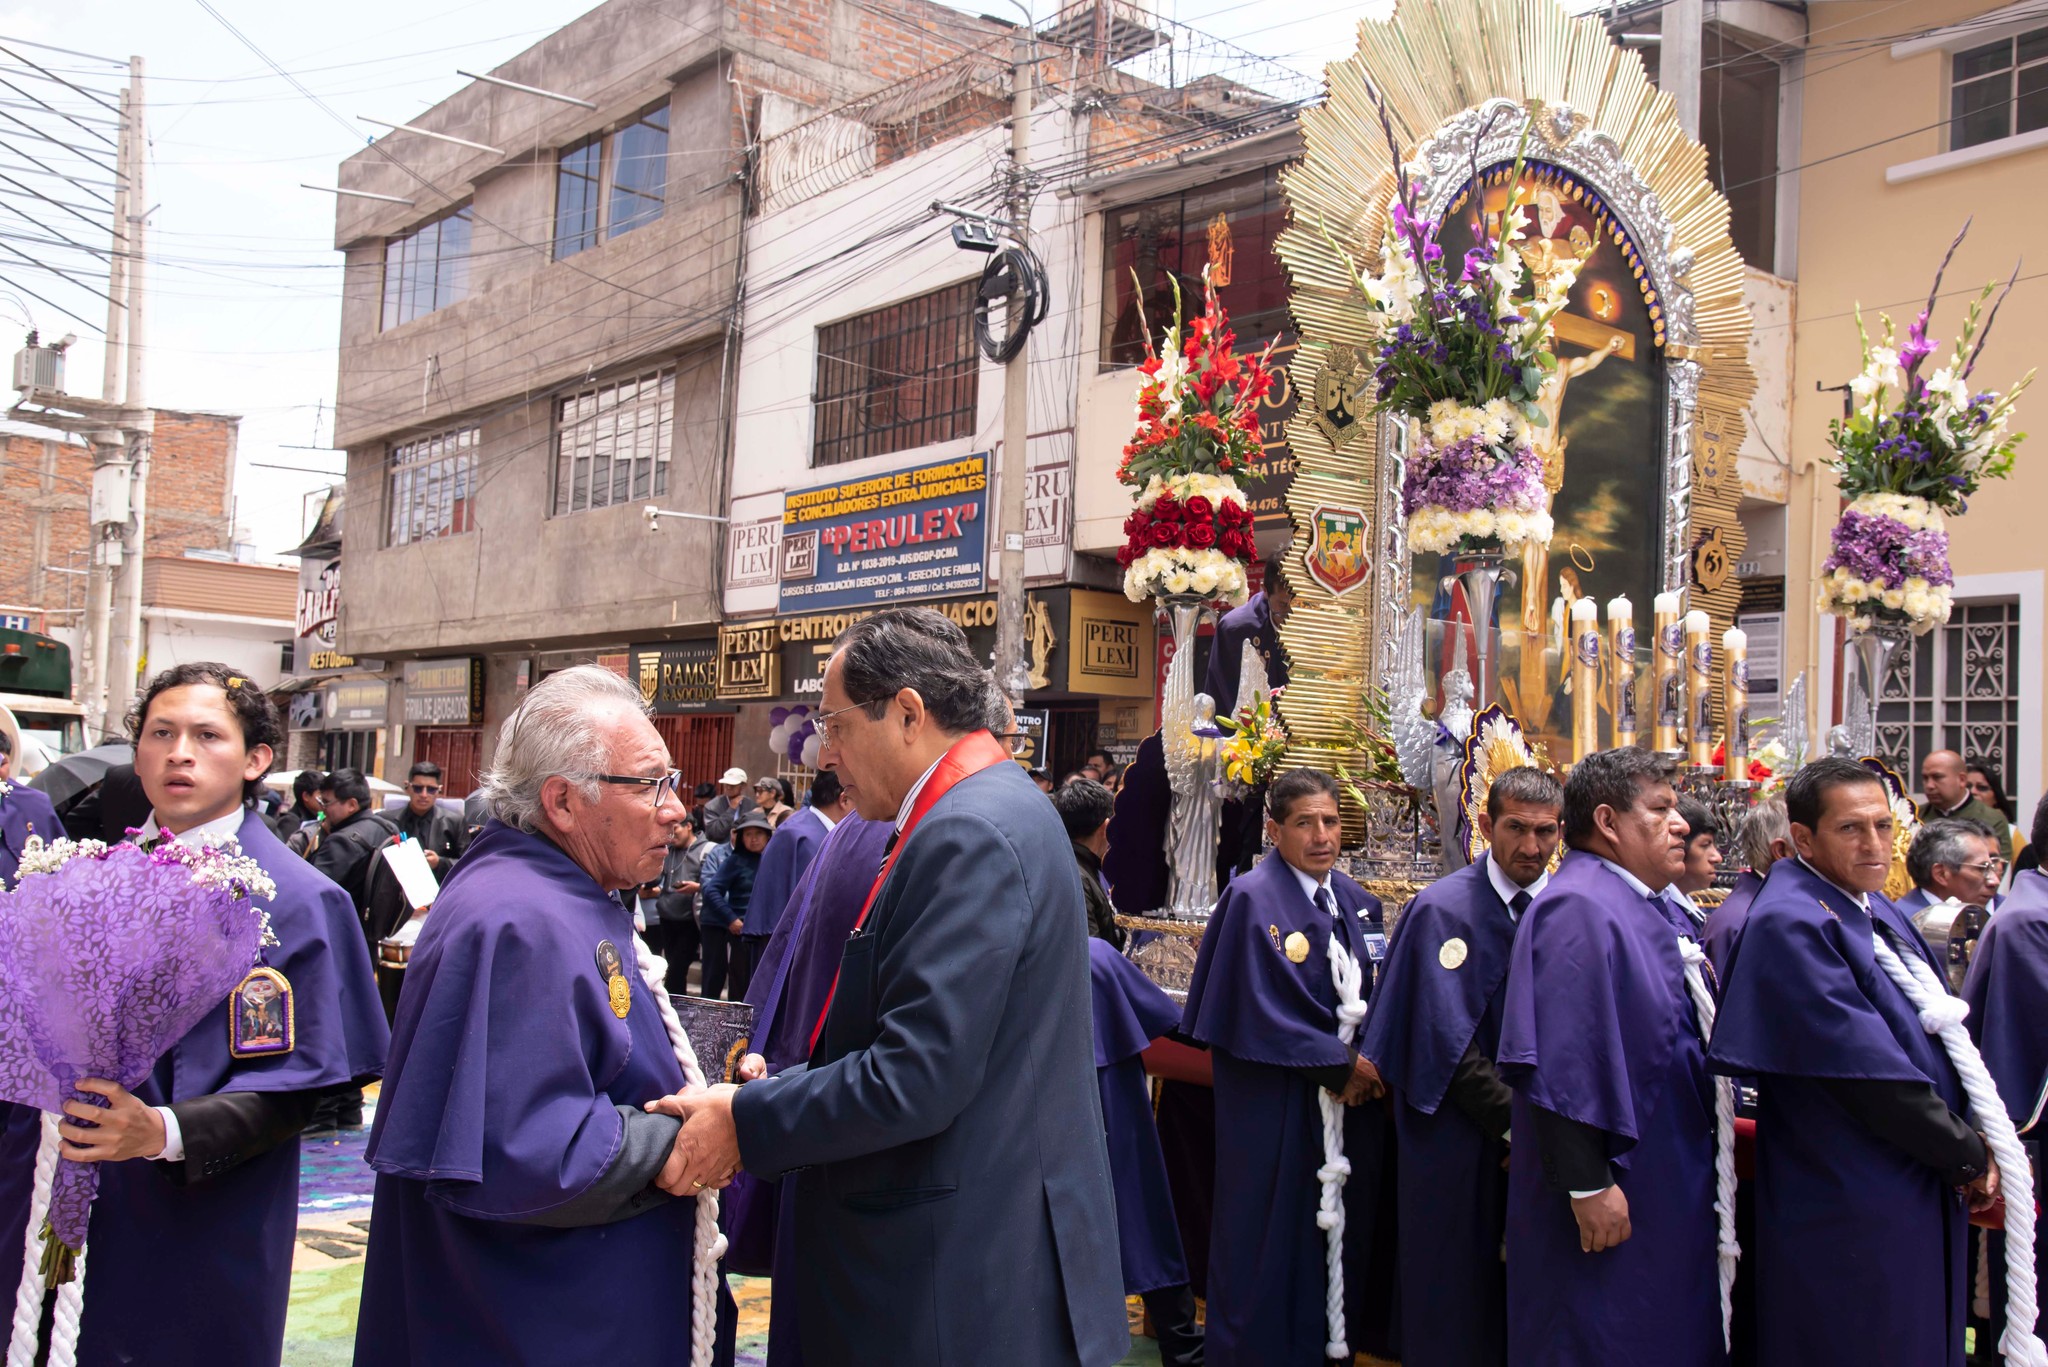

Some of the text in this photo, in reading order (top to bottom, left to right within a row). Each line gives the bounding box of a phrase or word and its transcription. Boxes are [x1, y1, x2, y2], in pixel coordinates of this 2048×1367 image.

[786, 456, 984, 509] INSTITUTO SUPERIOR DE FORMACIÓN
[1025, 470, 1068, 500] ERU
[783, 475, 986, 525] DE CONCILIADORES EXTRAJUDICIALES
[1259, 497, 1279, 510] 476
[1025, 506, 1050, 532] EX
[737, 524, 780, 549] PERU
[786, 536, 816, 553] PERU
[1024, 535, 1061, 546] ABORALISTAS
[741, 552, 768, 575] LEX
[790, 554, 809, 569] LEX
[837, 562, 851, 573] R.D.
[782, 586, 805, 597] CURSOS
[805, 584, 814, 594] DE
[815, 577, 855, 592] CONCILIACIÓN
[856, 574, 887, 587] DERECHO
[888, 573, 903, 583] CIVIL
[908, 568, 940, 581] DERECHO
[941, 567, 951, 576] DE
[953, 562, 981, 575] FAMILIA
[780, 615, 847, 641] CENTRO
[1090, 624, 1139, 645] PERU
[725, 628, 775, 654] PERU
[1097, 646, 1126, 665] LEX
[663, 656, 716, 687] RAMSÉ
[731, 659, 761, 682] LEX
[662, 687, 670, 702] &
[406, 695, 468, 720] FIRMA DE ABOGADOS
[1014, 715, 1042, 725] NTRO
[1100, 728, 1115, 738] 630
